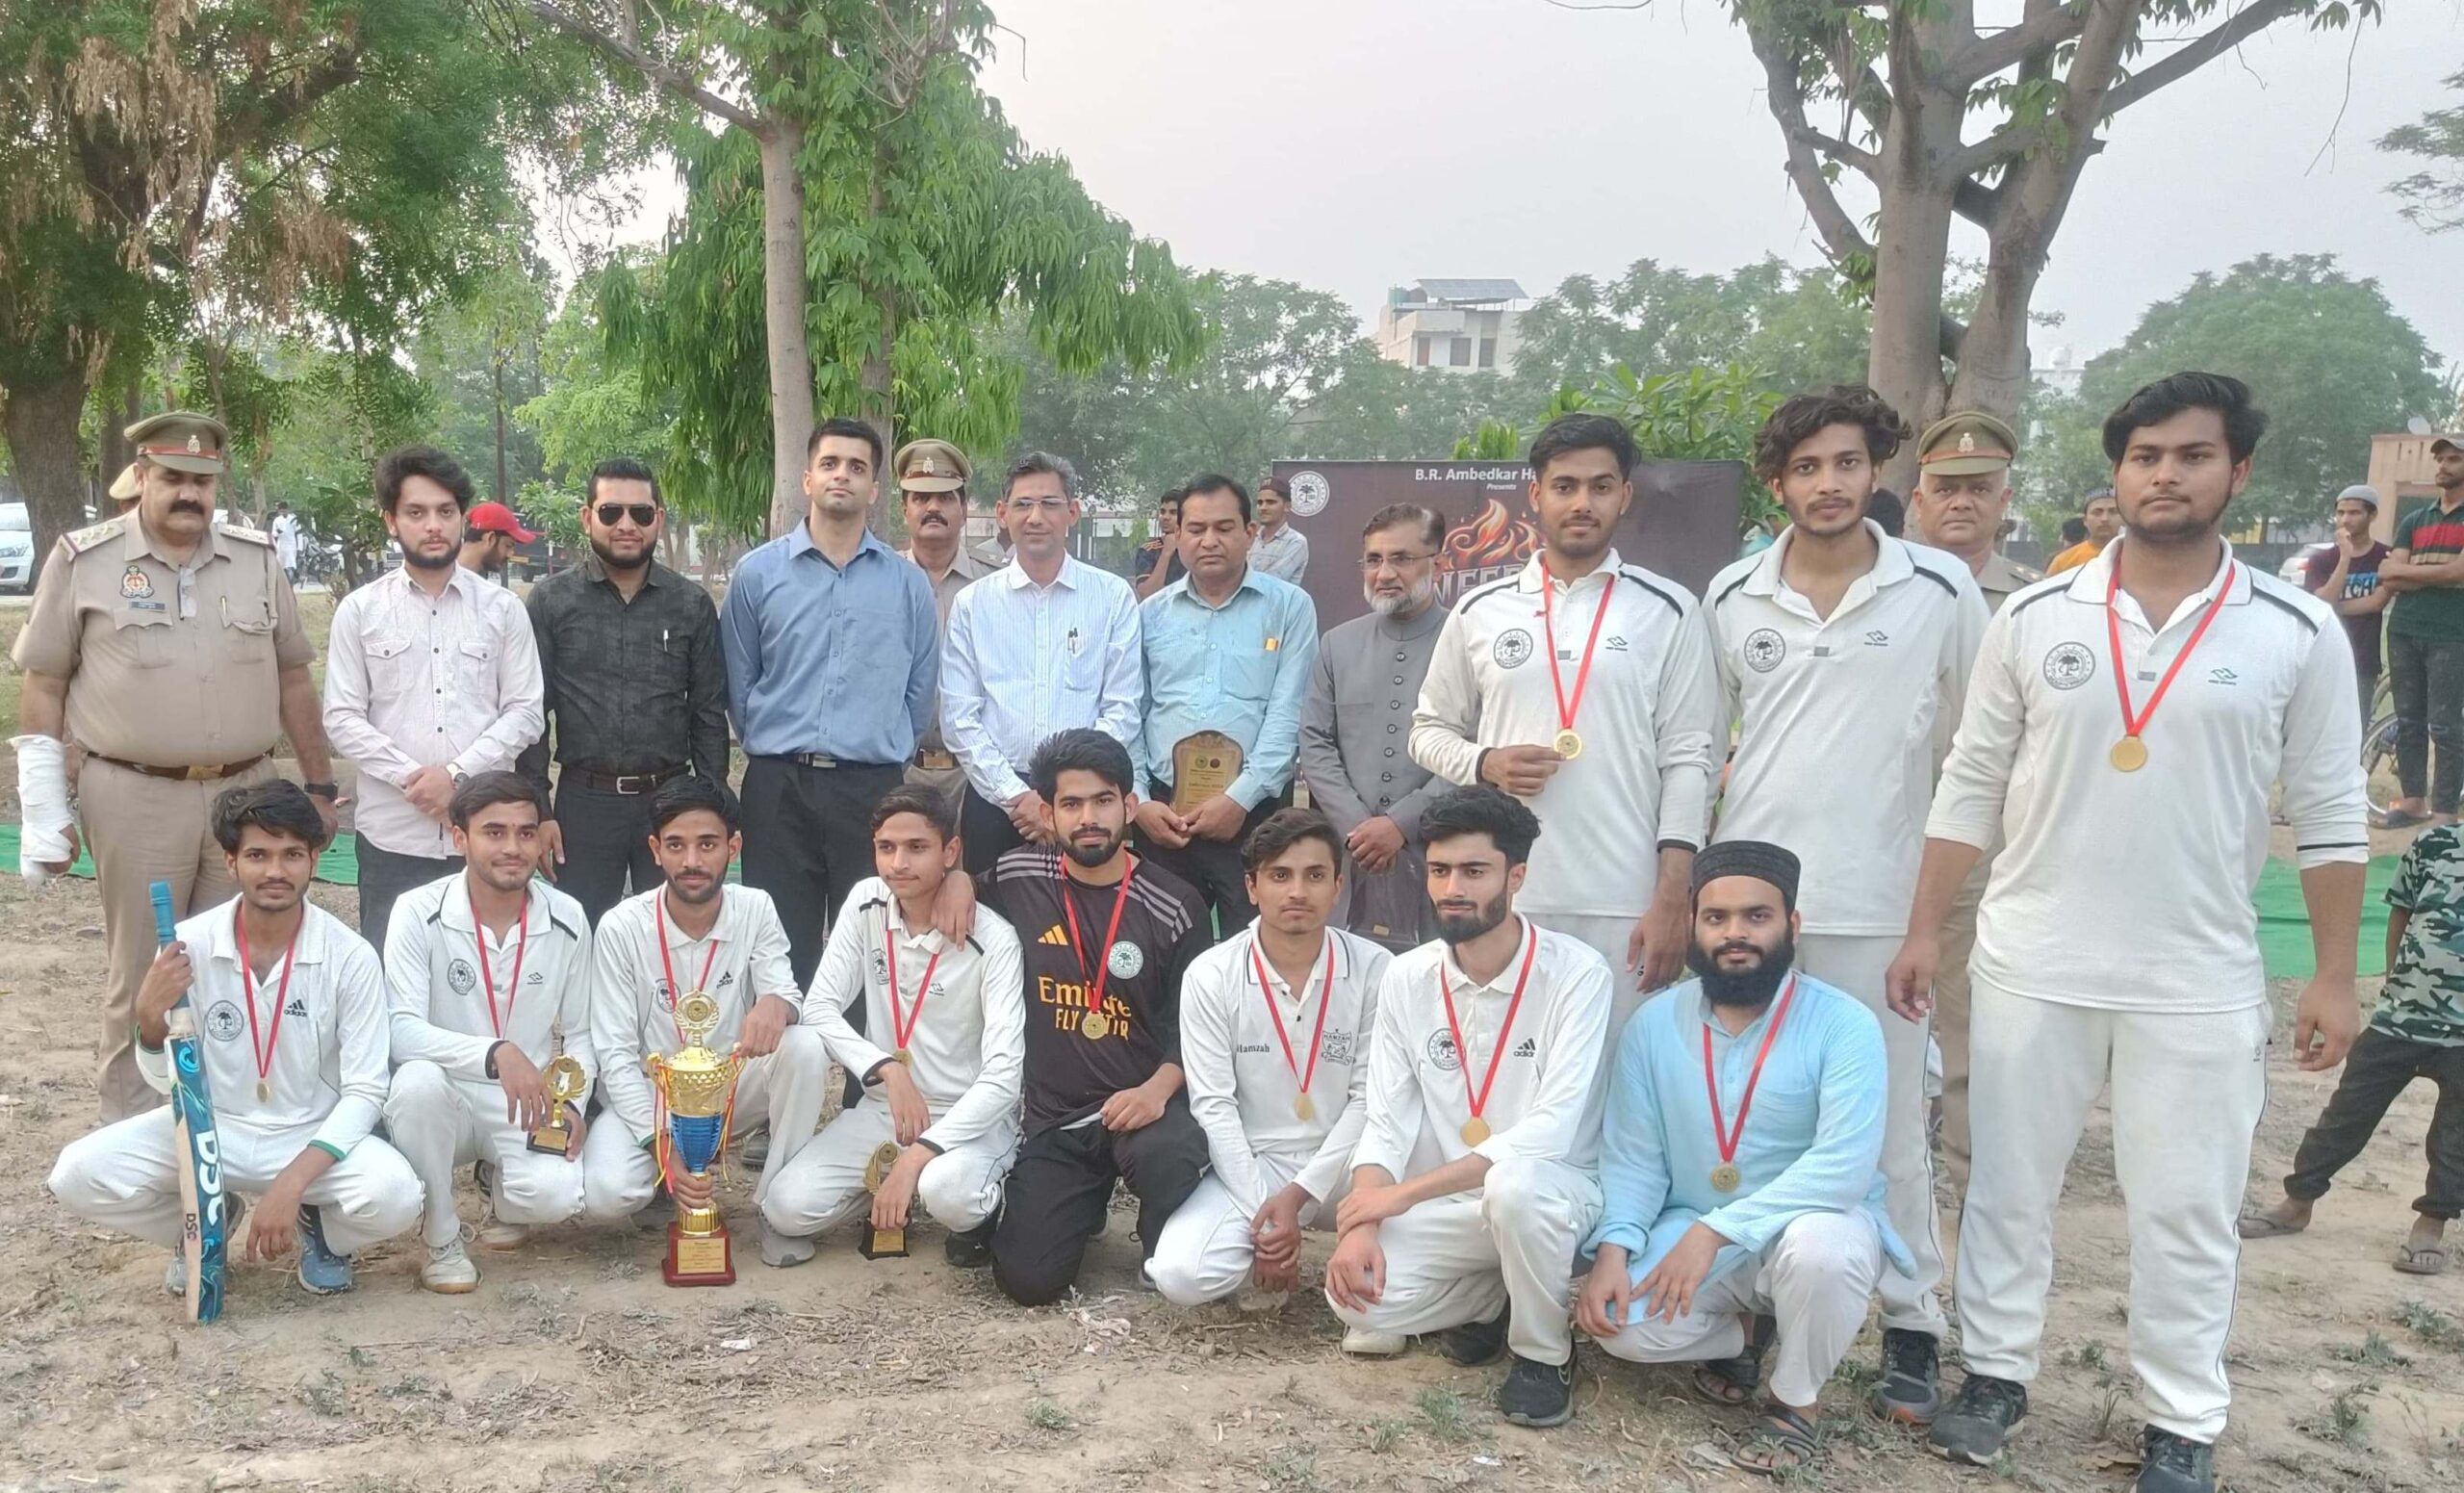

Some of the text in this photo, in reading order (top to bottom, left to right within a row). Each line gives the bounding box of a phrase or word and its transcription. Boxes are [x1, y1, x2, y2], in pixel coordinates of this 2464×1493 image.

[1415, 468, 1442, 480] B.R.
[1446, 467, 1518, 480] Ambedkar
[1056, 1008, 1080, 1031] FLY
[185, 1213, 198, 1241] DSC
